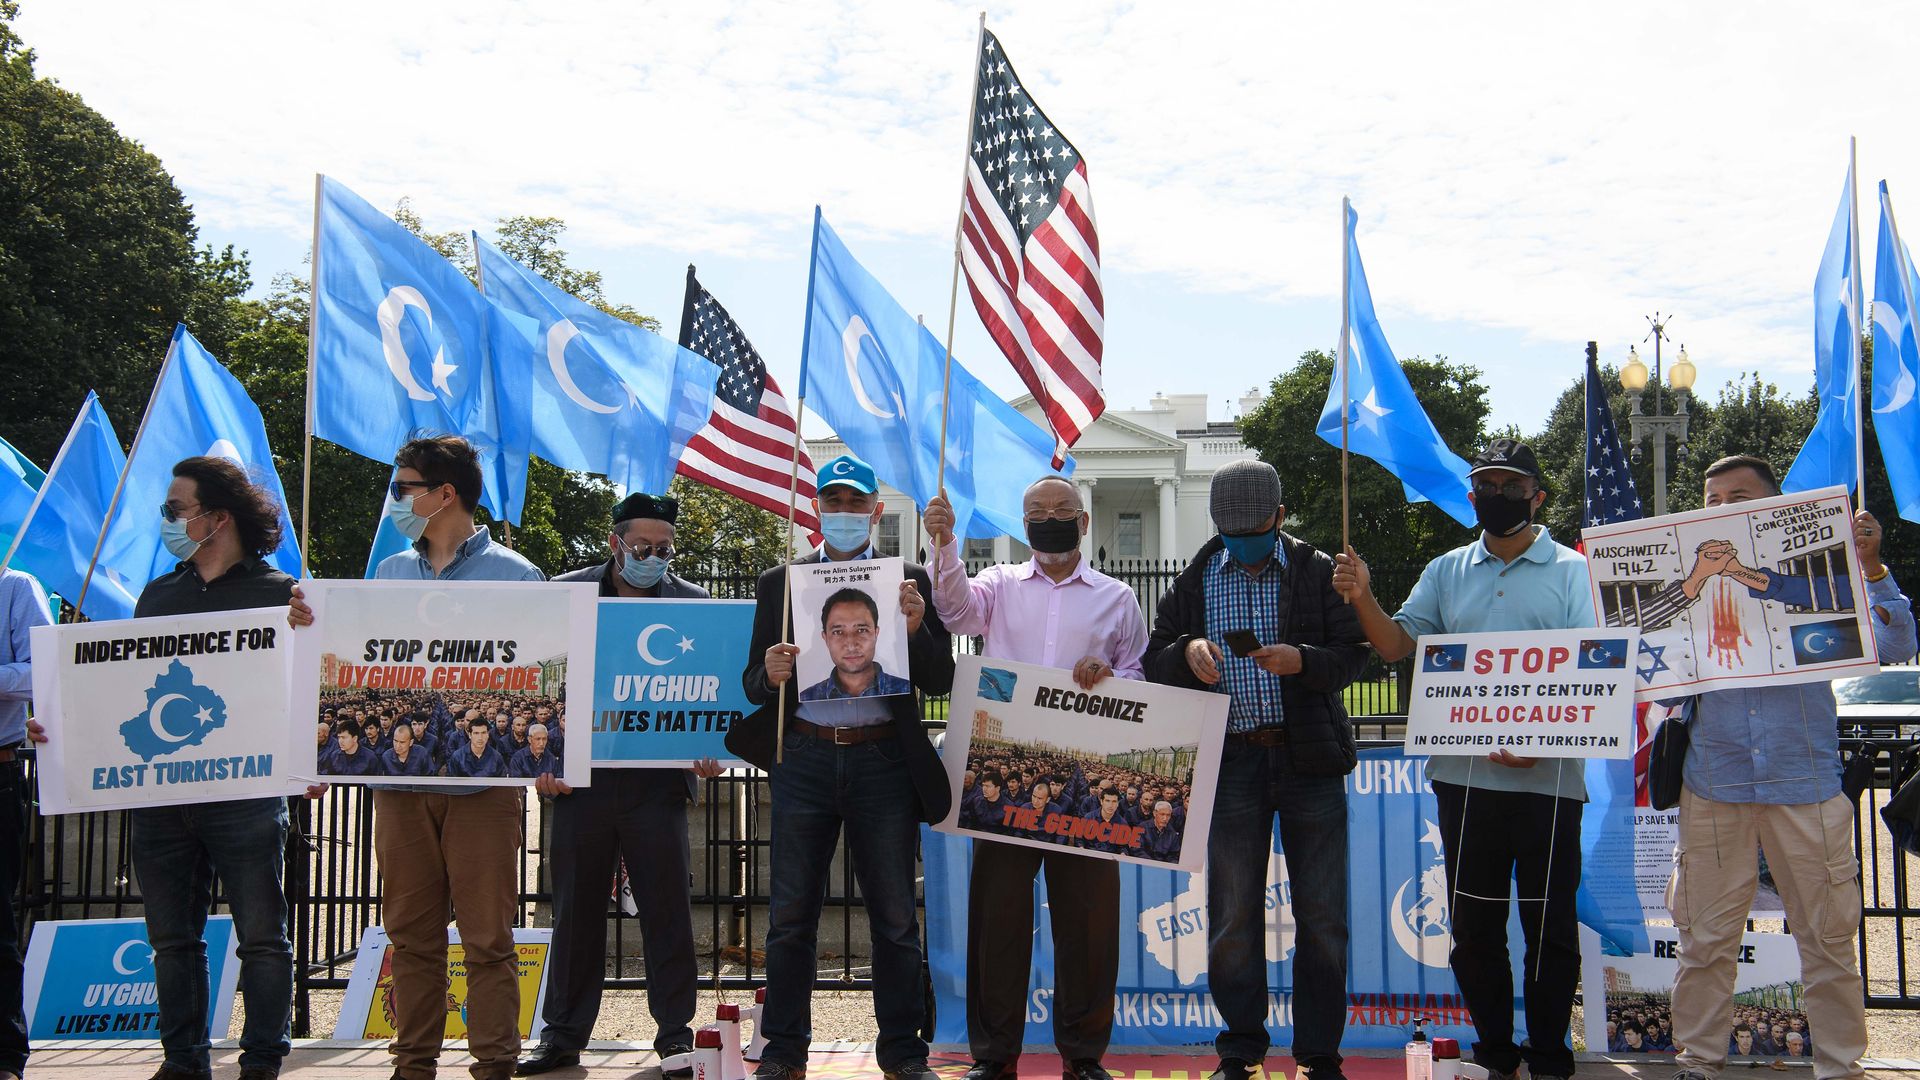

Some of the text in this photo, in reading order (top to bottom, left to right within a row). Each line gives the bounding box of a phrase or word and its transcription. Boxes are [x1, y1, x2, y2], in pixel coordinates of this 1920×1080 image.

[1756, 506, 1843, 532] CONCENTRATION
[1772, 502, 1820, 519] CHINESE
[1782, 525, 1833, 552] 2020
[1784, 521, 1820, 535] CAMPS
[1593, 544, 1668, 559] AUSCHWITZ
[849, 565, 880, 573] Sulayman
[1613, 559, 1658, 576] 1942
[74, 627, 276, 664] INDEPENDENCE FOR
[363, 638, 517, 664] STOP CHINA'S
[1473, 647, 1570, 675] STOP
[337, 666, 541, 690] UYGHUR GENOCIDE
[613, 675, 720, 702] UYGHUR
[1425, 683, 1617, 698] CHINA'S 21ST CENTURY
[1034, 685, 1148, 723] RECOGNIZE
[1450, 705, 1595, 724] HOLOCAUST
[592, 710, 650, 732] LIVES
[1414, 735, 1619, 747] IN OCCUPIED EAST TURKISTAN
[92, 754, 273, 790] EAST TURKISTAN
[1003, 805, 1146, 848] THE GENOCIDE
[1645, 815, 1665, 825] SAVE
[1156, 907, 1203, 942] EAST
[520, 947, 539, 955] Out
[83, 982, 159, 1008] UYGHU
[1113, 993, 1223, 1028] RKISTAN
[54, 1013, 111, 1034] LIVES
